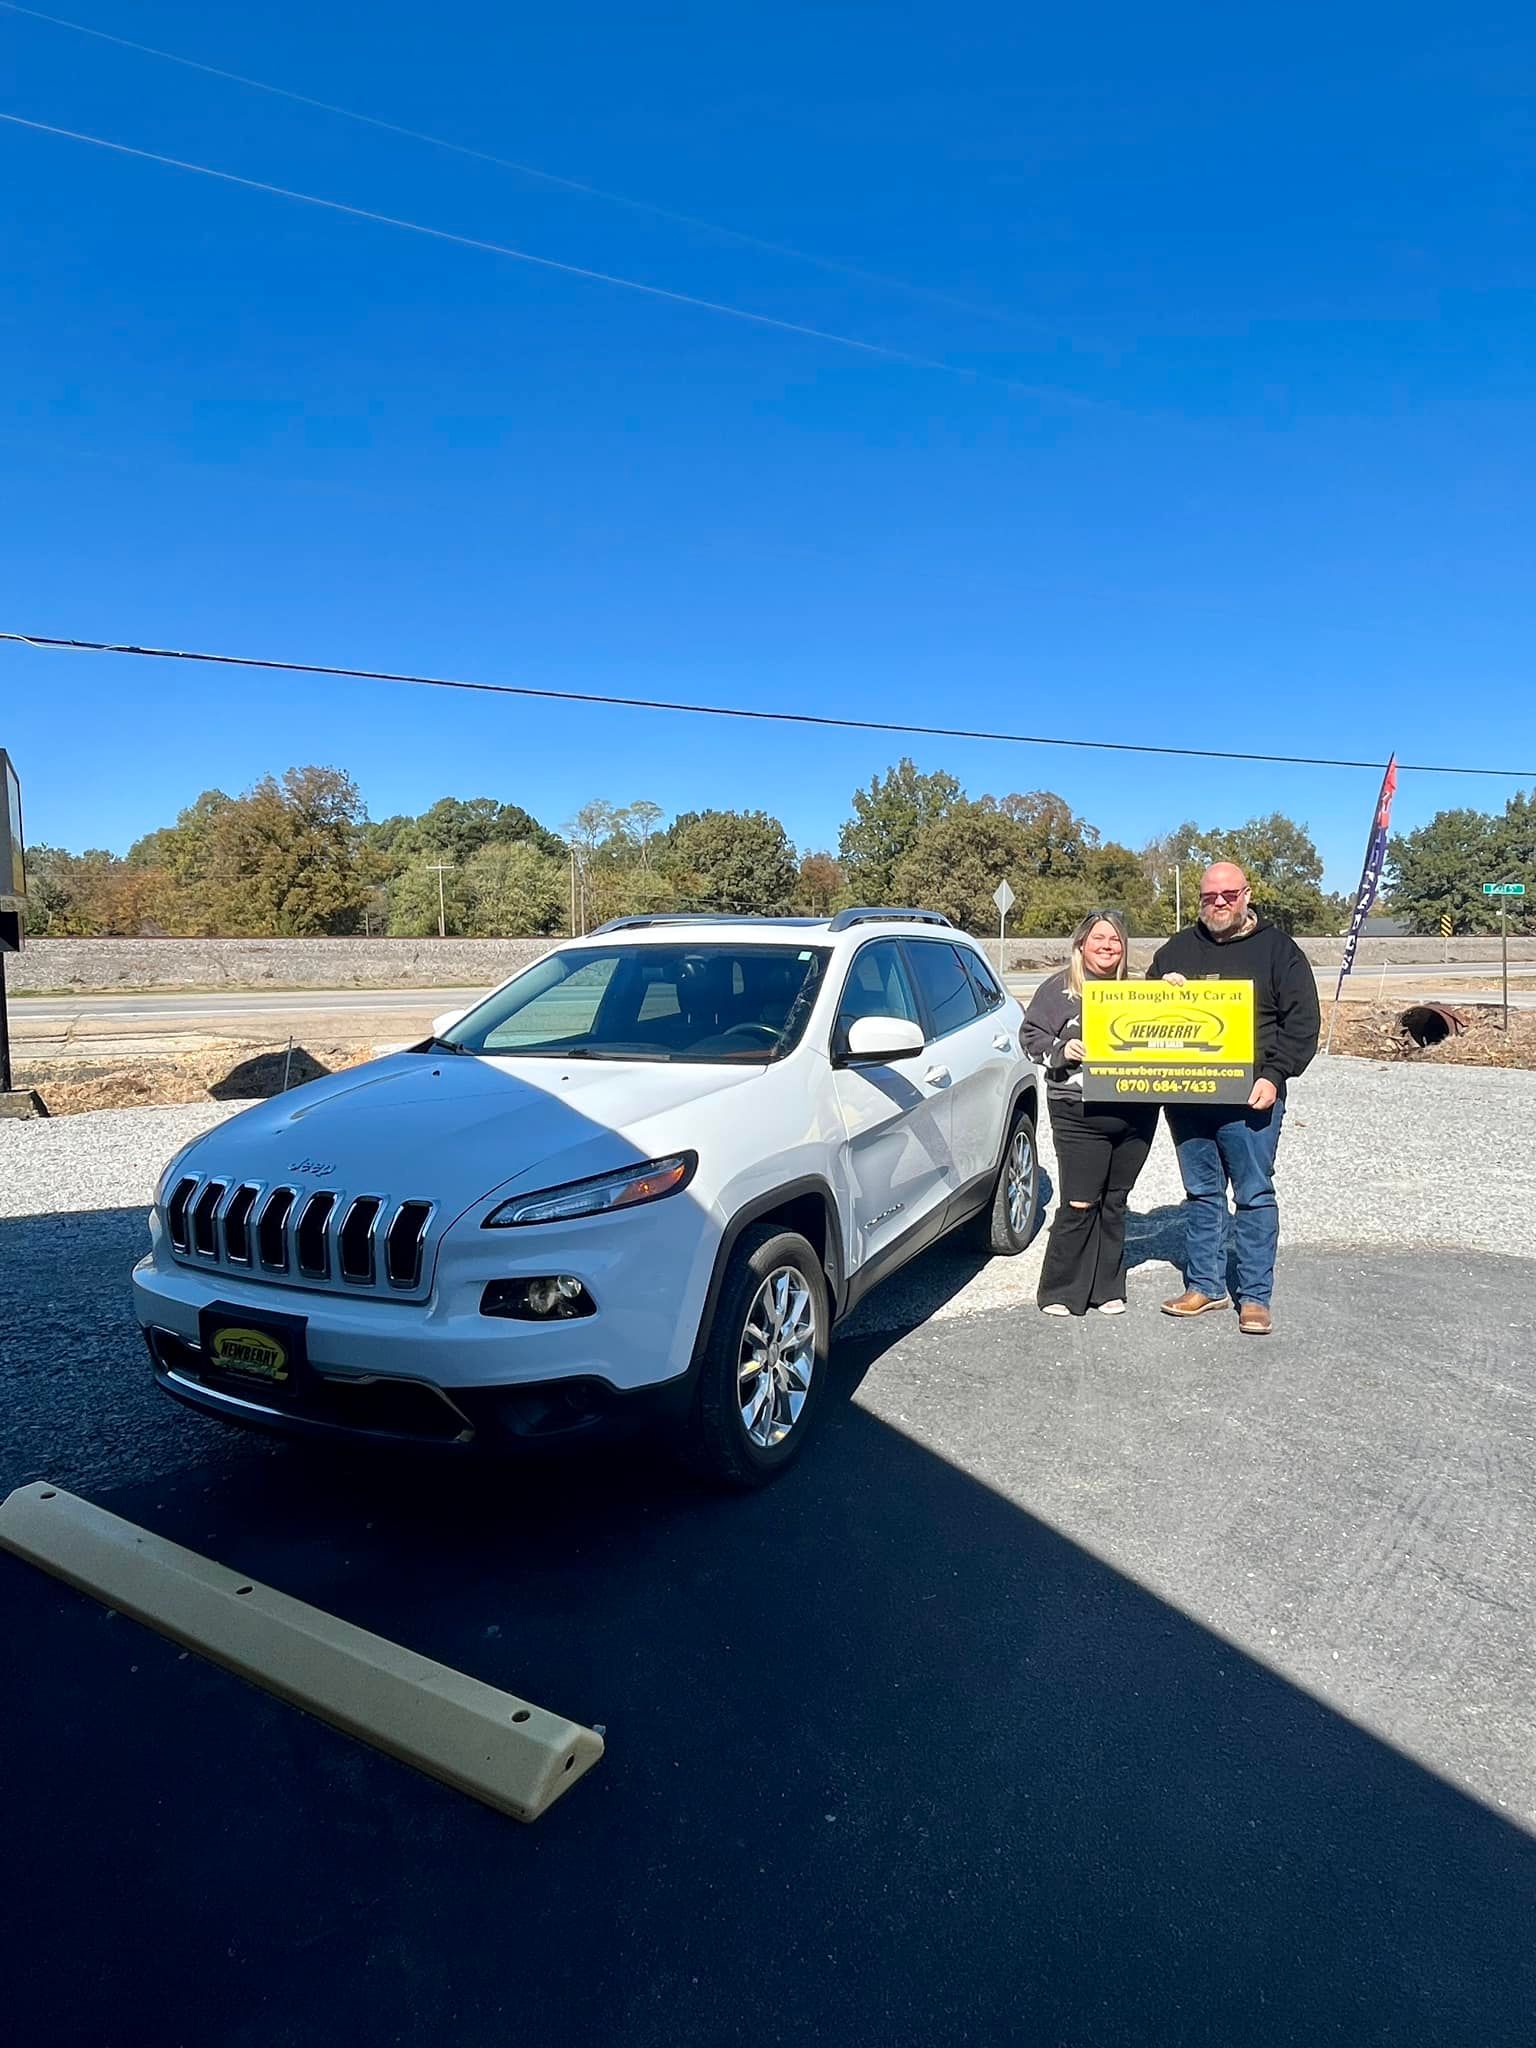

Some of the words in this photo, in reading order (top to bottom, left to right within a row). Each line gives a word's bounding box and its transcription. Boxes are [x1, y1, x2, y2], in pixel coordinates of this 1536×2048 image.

[1091, 991, 1096, 1001] I
[1100, 991, 1124, 1003] Just
[1128, 991, 1175, 1003] Bought
[1179, 991, 1199, 1003] My
[1203, 990, 1225, 1001] Car
[1229, 991, 1243, 1001] at
[1129, 1024, 1201, 1039] NEWBERRY
[1089, 1066, 1245, 1078] www.newberryautosales.com
[1115, 1079, 1149, 1093] (870)
[1152, 1080, 1217, 1093] 684-7433
[288, 1158, 336, 1177] Jeep
[221, 1341, 279, 1367] NEWBERRY
